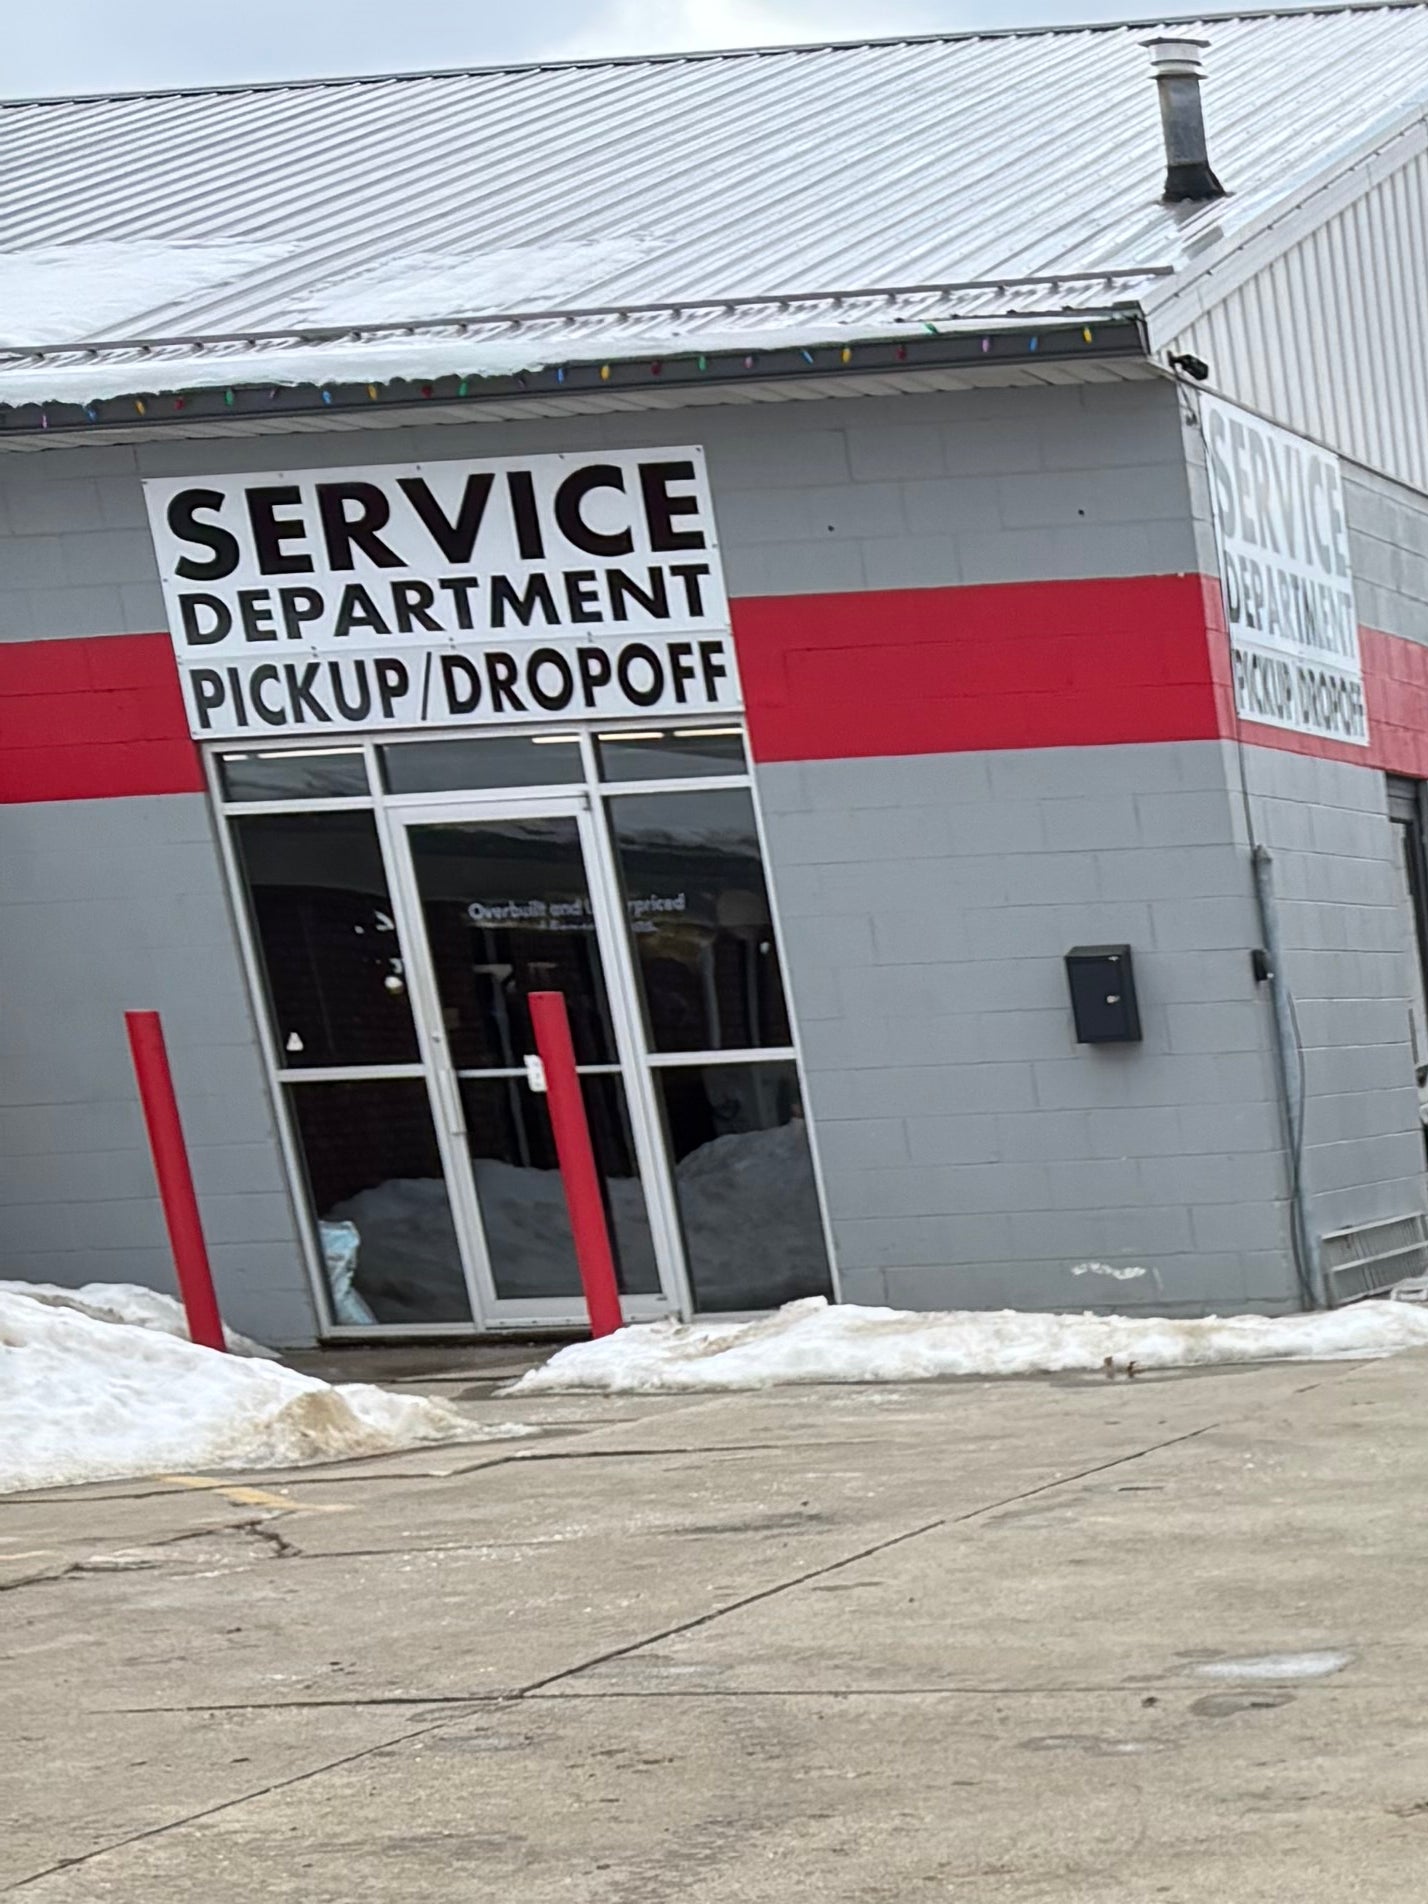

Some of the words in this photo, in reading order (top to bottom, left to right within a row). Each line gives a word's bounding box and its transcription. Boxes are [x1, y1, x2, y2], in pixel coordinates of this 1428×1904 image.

[167, 460, 707, 582] SERVICE
[1208, 409, 1348, 578] SERVICE
[177, 563, 710, 646] DEPARTMENT
[1225, 550, 1355, 660] DEPARTMENT
[189, 640, 728, 729] PICKUP/DROPOFF
[549, 898, 583, 917] and
